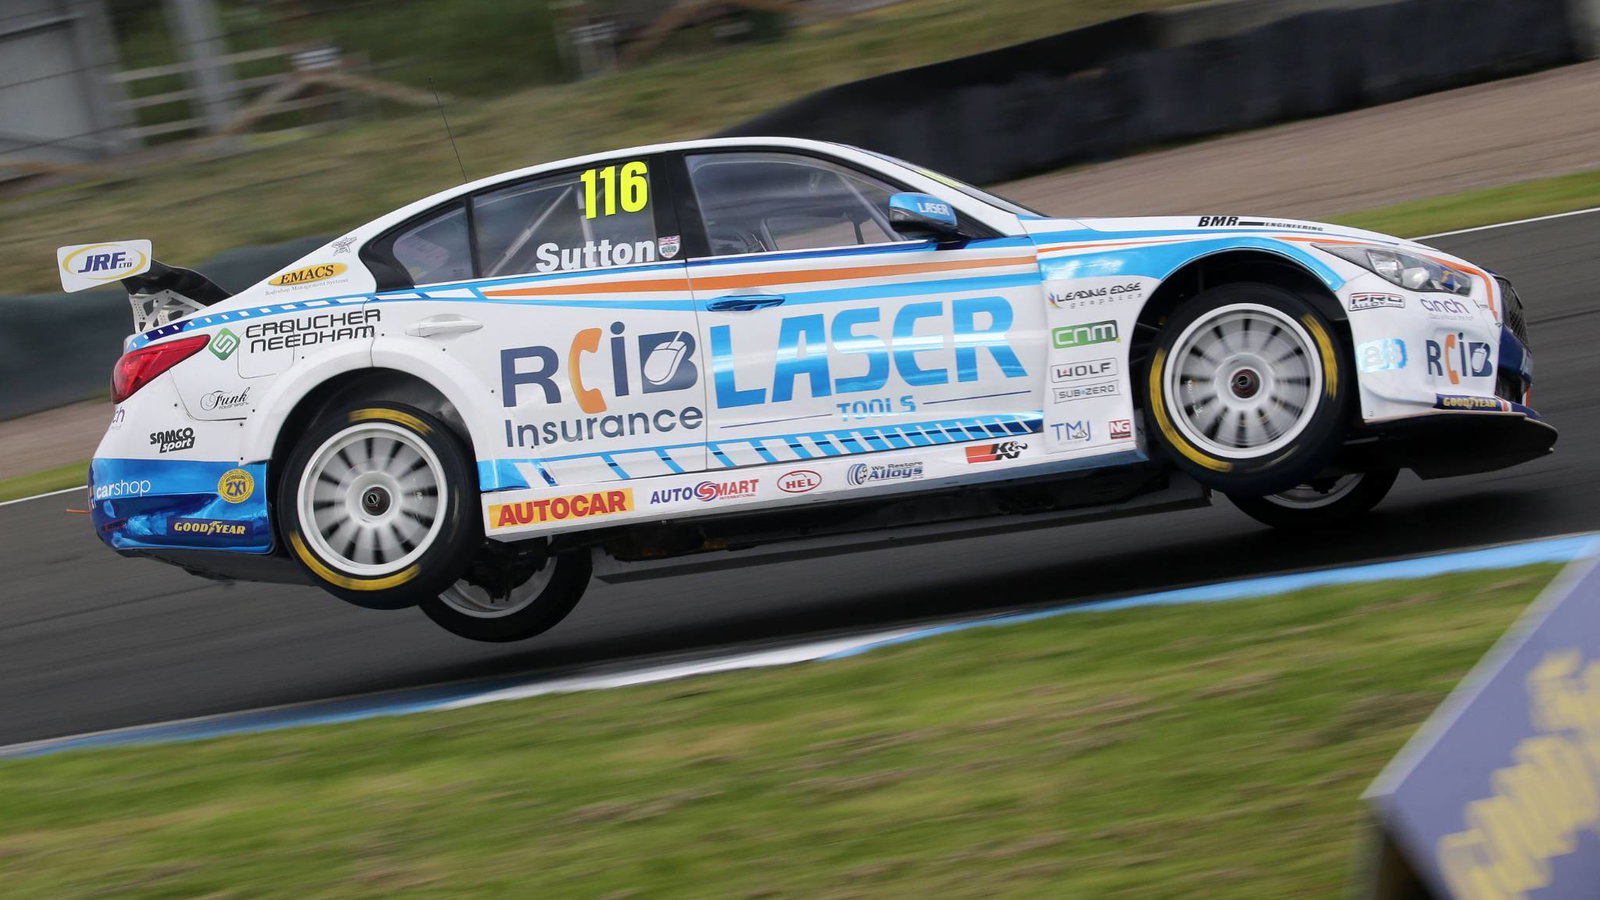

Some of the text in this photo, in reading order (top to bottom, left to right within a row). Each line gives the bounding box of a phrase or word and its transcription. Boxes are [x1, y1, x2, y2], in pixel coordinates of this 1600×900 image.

[580, 161, 649, 219] 116
[916, 202, 950, 216] LASER
[1197, 216, 1324, 232] BMR ENGINEERING
[77, 251, 127, 273] JRF
[535, 239, 655, 273] Sutton
[279, 264, 335, 285] EMACS
[1056, 282, 1142, 302] LEADING EDGE
[1352, 293, 1402, 305] PRO
[1351, 300, 1385, 310] ALLOY
[1420, 298, 1470, 314] cinch
[245, 308, 382, 339] CROUCHER
[250, 325, 376, 354] NEEDHAM
[710, 296, 1028, 409] LASER
[1056, 362, 1112, 378] WOLF
[200, 387, 251, 411] Funk
[836, 395, 917, 422] TOOLS
[150, 426, 194, 445] SAMCO
[505, 406, 704, 448] Insurance
[1050, 420, 1092, 441] TMJ
[160, 437, 193, 453] sport
[785, 478, 816, 490] HEL
[867, 466, 924, 481] Alloys
[96, 479, 151, 500] carshop
[498, 490, 627, 527] AUTOCAR
[173, 520, 246, 536] GOODYEAR
